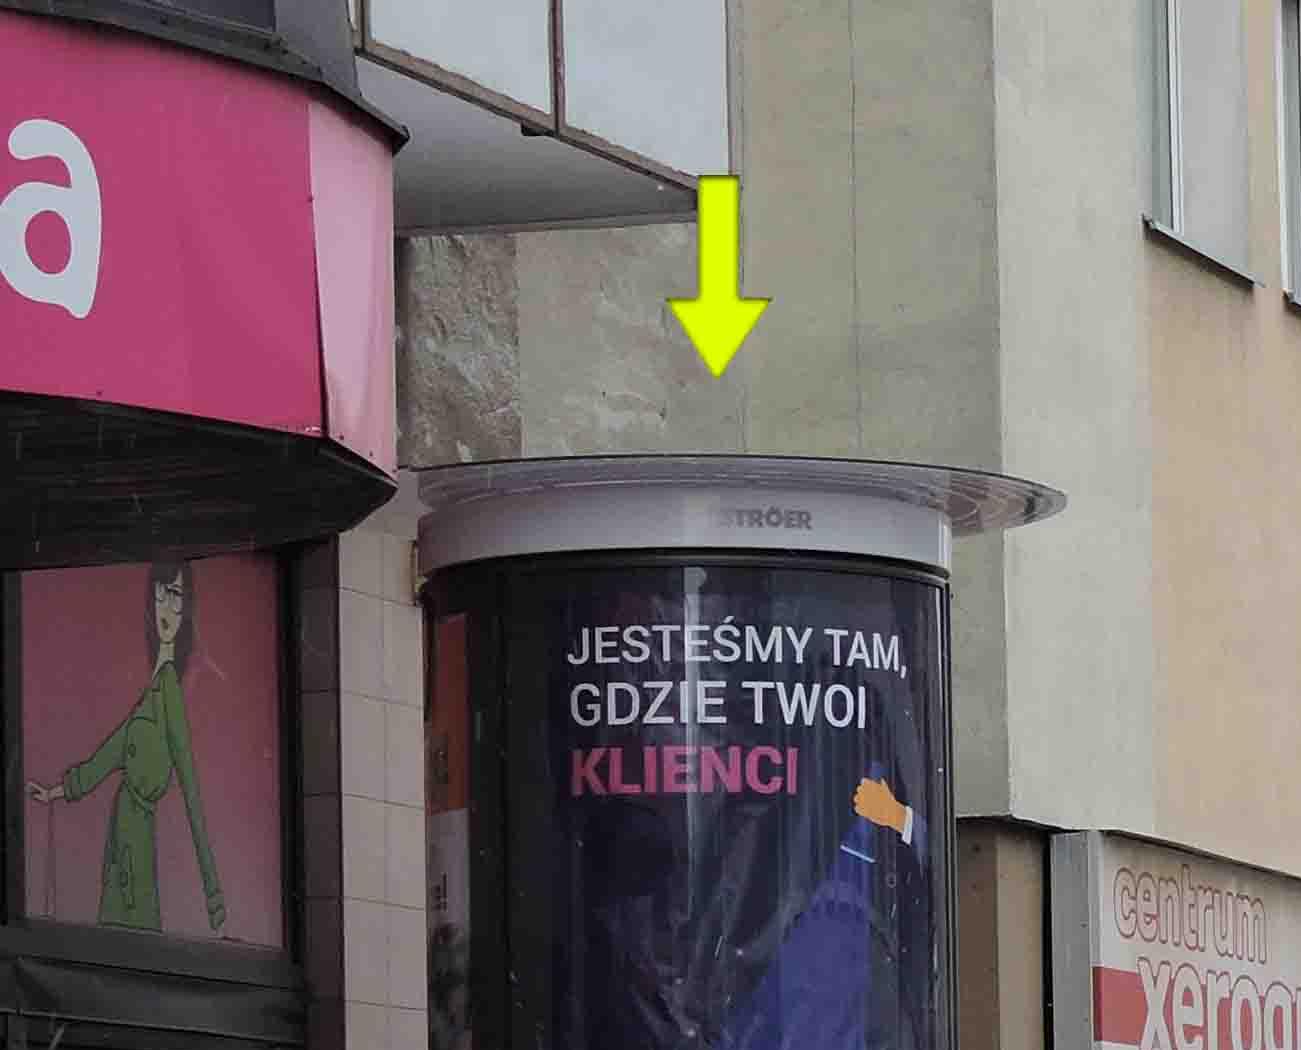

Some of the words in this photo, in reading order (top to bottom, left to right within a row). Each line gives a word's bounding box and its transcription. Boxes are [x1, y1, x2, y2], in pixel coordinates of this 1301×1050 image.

[567, 616, 814, 665] JESTEŚMY
[823, 628, 908, 679] TAM,
[570, 680, 727, 727] GDZIE
[741, 681, 867, 729] TWOI
[571, 745, 800, 796] KLIENCI
[1113, 863, 1267, 965] centrum
